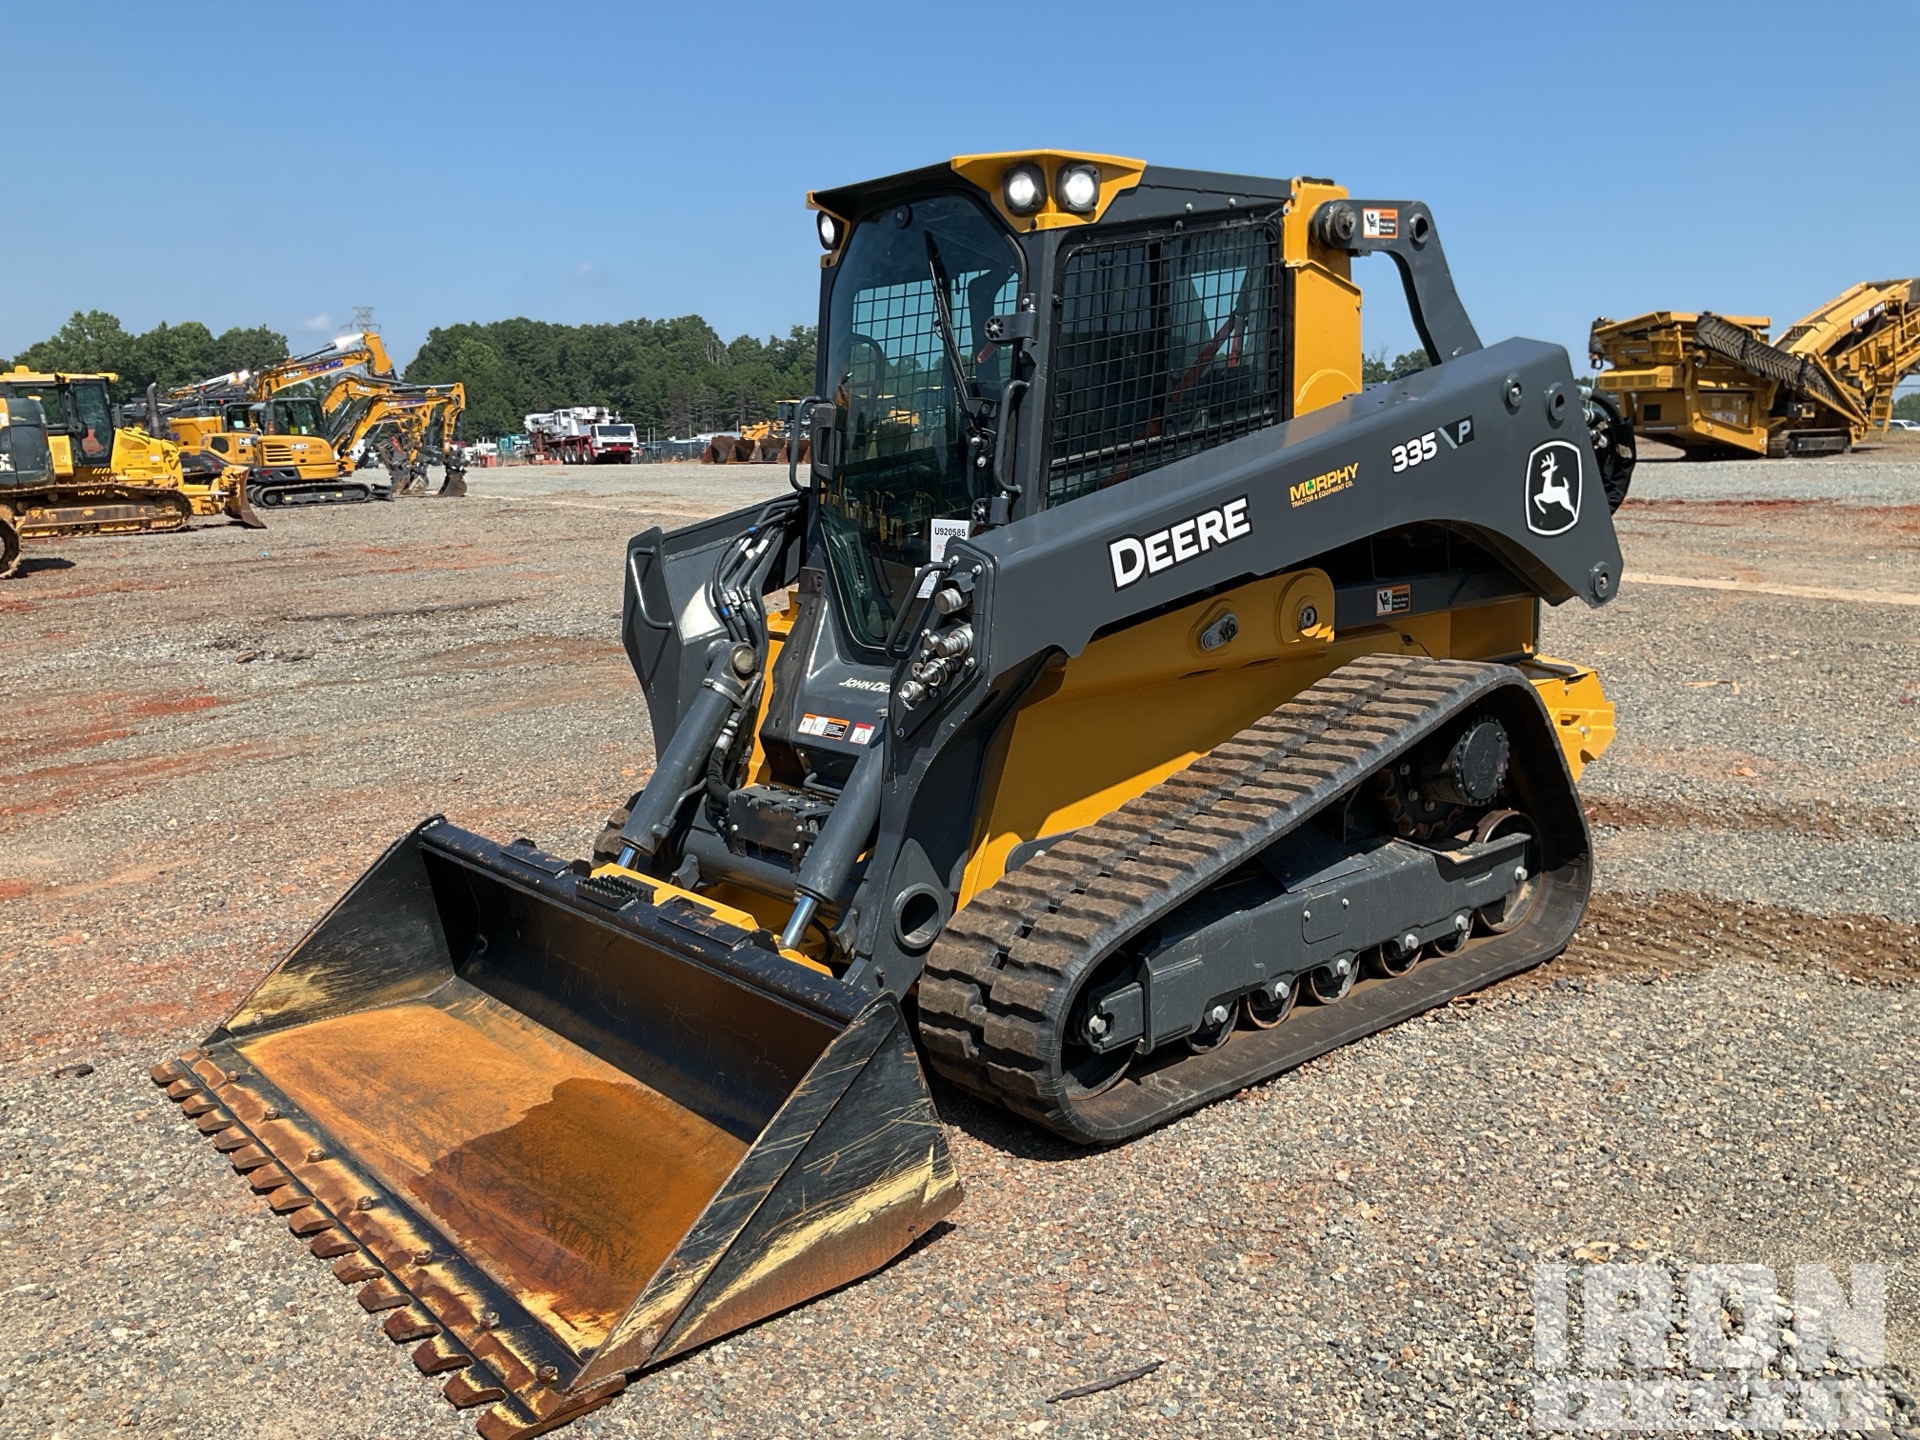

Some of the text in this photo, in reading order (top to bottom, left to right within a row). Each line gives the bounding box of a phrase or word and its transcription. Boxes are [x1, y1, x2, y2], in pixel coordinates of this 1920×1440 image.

[1391, 431, 1437, 473] 335
[1289, 462, 1359, 501] MURPHY
[1291, 495, 1314, 509] TRACTOR
[1318, 483, 1345, 499] EQUIPMENT
[934, 527, 966, 537] U920585
[1110, 497, 1250, 588] DEERE
[838, 677, 891, 693] JOHN DE
